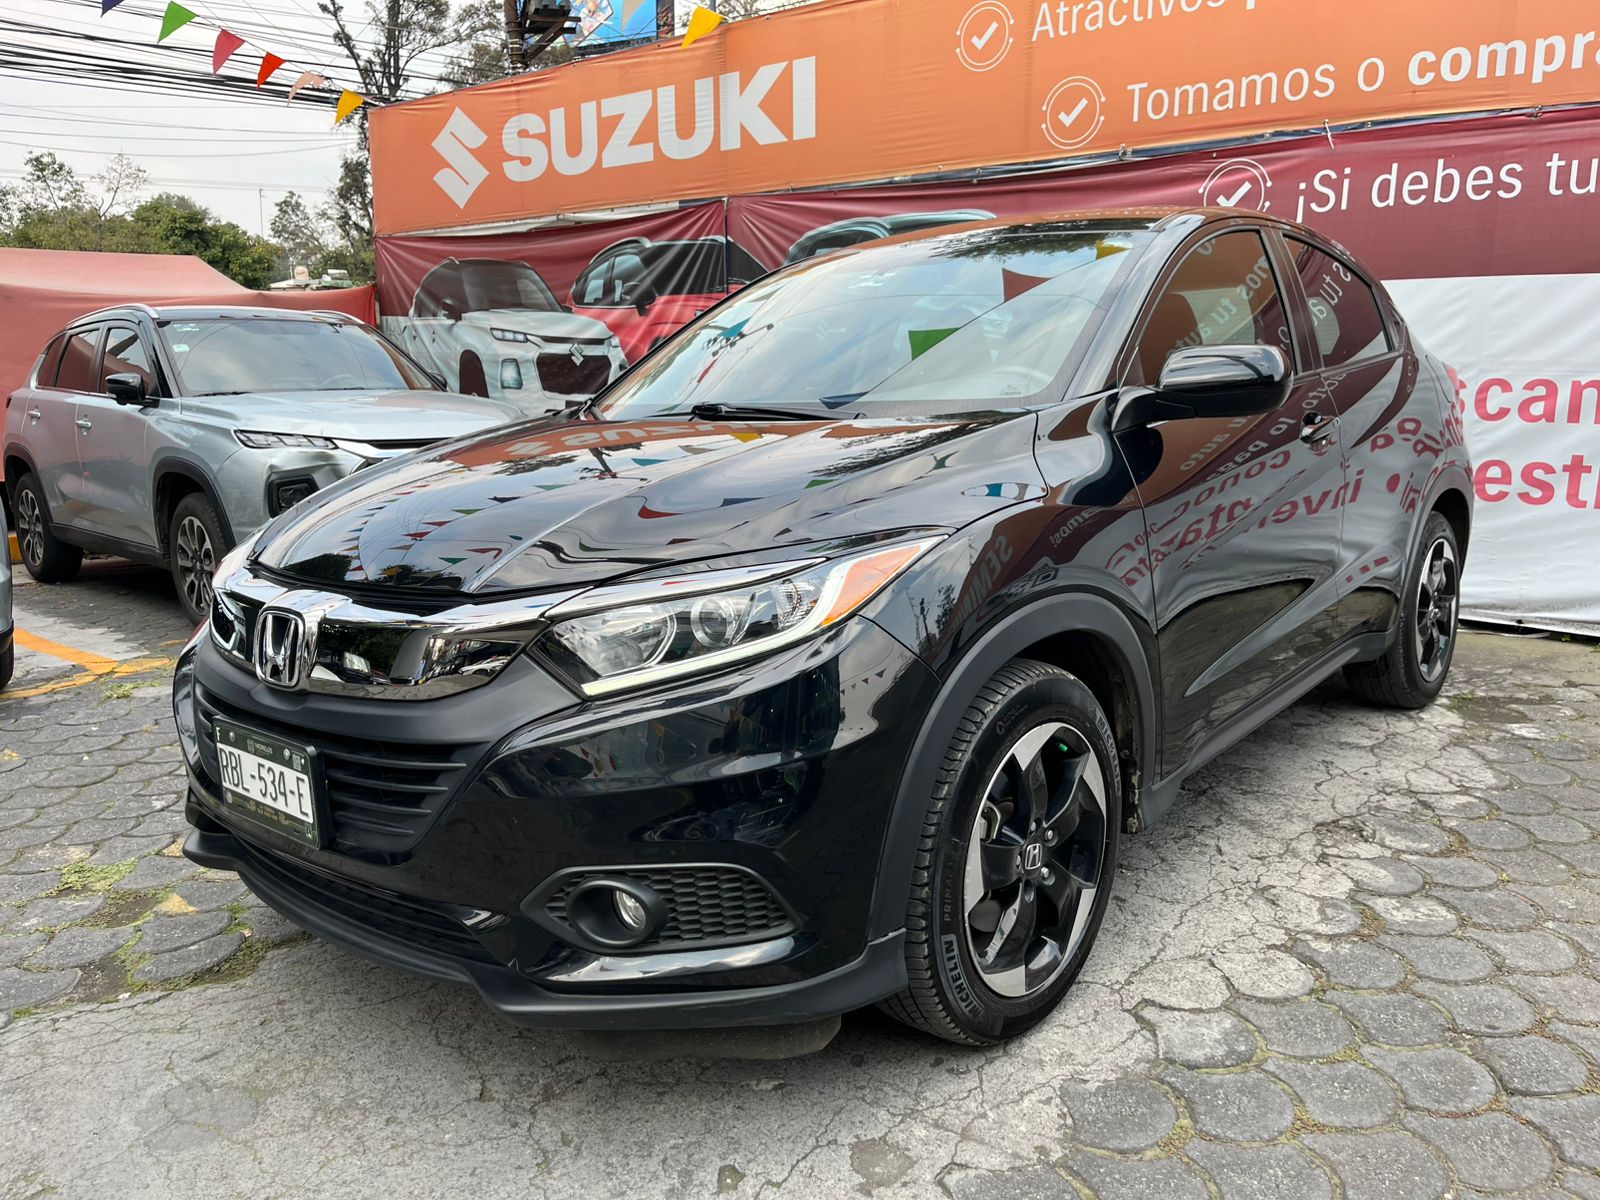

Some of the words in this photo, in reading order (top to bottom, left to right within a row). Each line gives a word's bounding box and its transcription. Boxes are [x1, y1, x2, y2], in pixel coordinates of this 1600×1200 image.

[1032, 0, 1225, 42] Atract
[1126, 63, 1336, 123] Tomamos
[1357, 57, 1385, 92] o
[1408, 31, 1600, 84] compr
[501, 55, 817, 182] SUZUKI
[1296, 166, 1351, 224] ¡Si
[1371, 158, 1523, 209] debes
[1473, 454, 1600, 510] est
[219, 747, 309, 818] RBL-534-E
[944, 938, 985, 1018] MICHELIN
